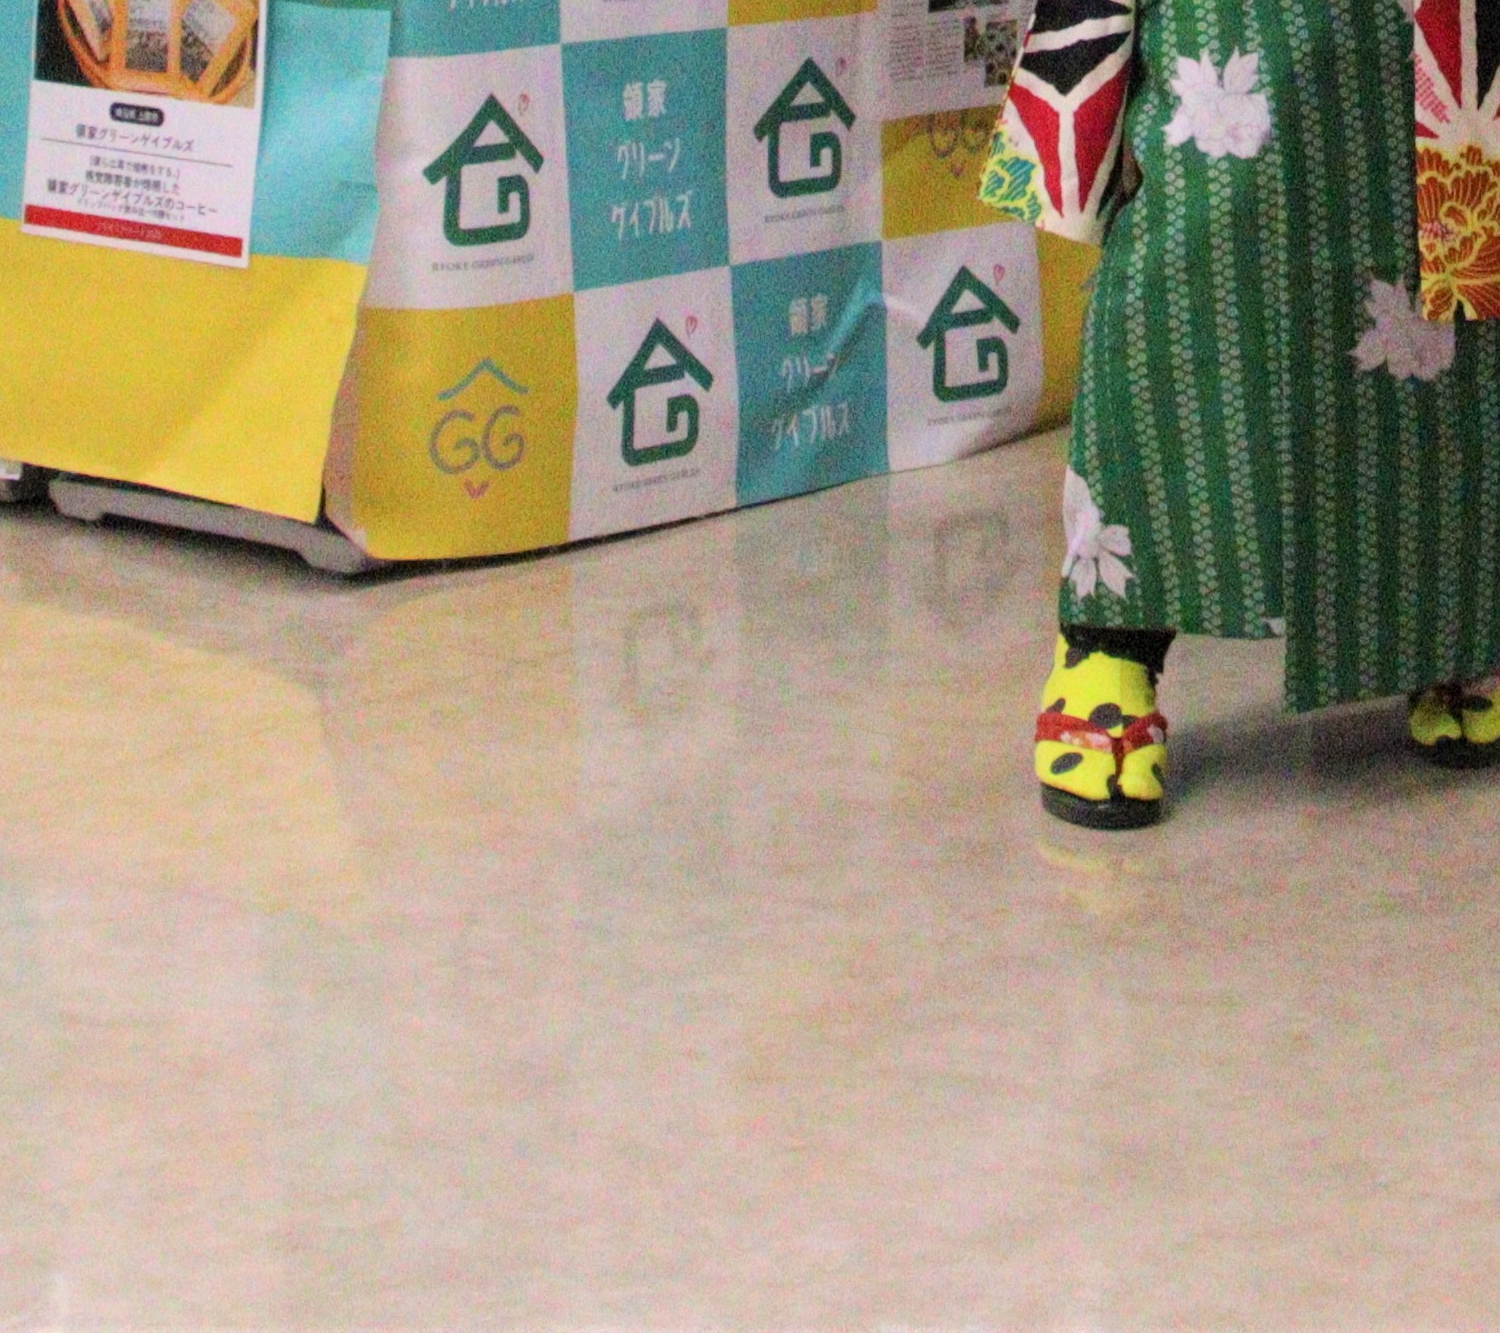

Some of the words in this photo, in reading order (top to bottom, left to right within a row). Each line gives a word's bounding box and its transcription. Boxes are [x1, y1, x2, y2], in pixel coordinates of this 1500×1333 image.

[615, 139, 683, 180] グリーン
[609, 187, 694, 241] ゲイブルズ
[428, 405, 529, 478] GG
